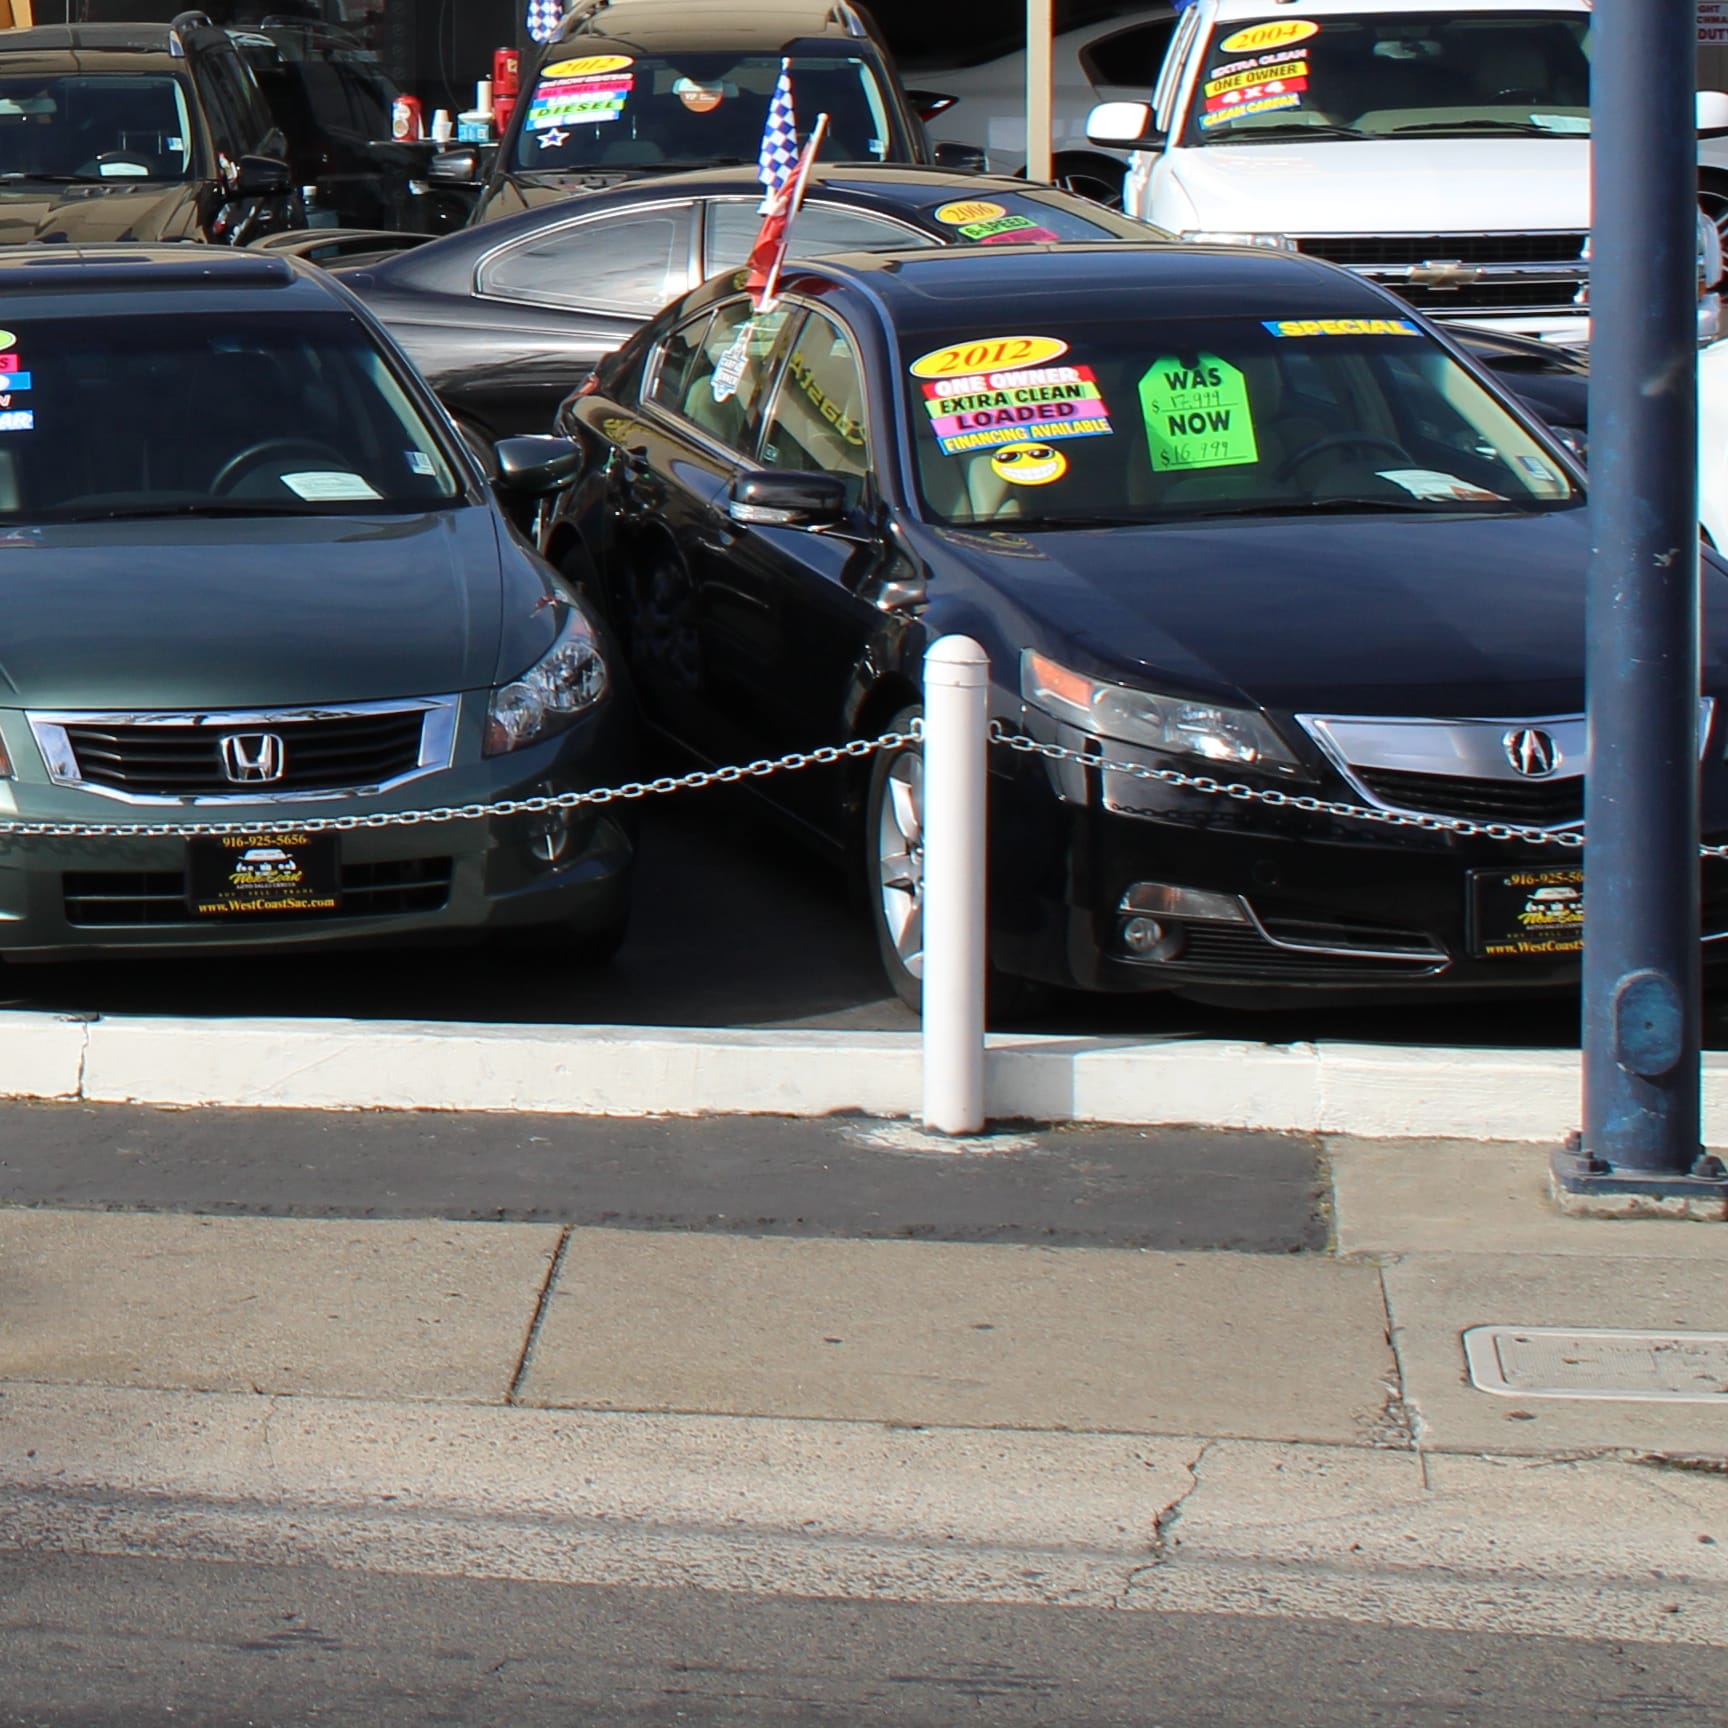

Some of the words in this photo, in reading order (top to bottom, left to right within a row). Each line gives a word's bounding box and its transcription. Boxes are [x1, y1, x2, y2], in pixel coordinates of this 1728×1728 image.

[1236, 23, 1299, 49] 2004
[558, 58, 616, 74] 2012
[1211, 58, 1258, 79] EXTRA
[1259, 49, 1308, 65] CLEAN
[1213, 76, 1243, 92] ONE
[1246, 64, 1299, 83] OWNER
[537, 101, 615, 118] DIESEL
[1277, 319, 1419, 337] SPECIAL
[937, 339, 1033, 373] 2012
[934, 377, 985, 397] ONE
[993, 368, 1080, 390] OWNER
[1164, 367, 1222, 390] WAS
[939, 392, 1009, 414] EXTRA
[1013, 384, 1082, 403] CLEAN
[1152, 400, 1160, 413] $
[956, 403, 1075, 430] LOADED
[1168, 409, 1232, 437] NOW
[945, 428, 1028, 451] FINANCING
[1030, 419, 1111, 439] AVAILABLE
[1160, 450, 1170, 467] $
[222, 834, 307, 847] 916-925-5656
[1511, 871, 1583, 885] 916-925-56
[198, 898, 335, 913] www.WestCoastSac.com
